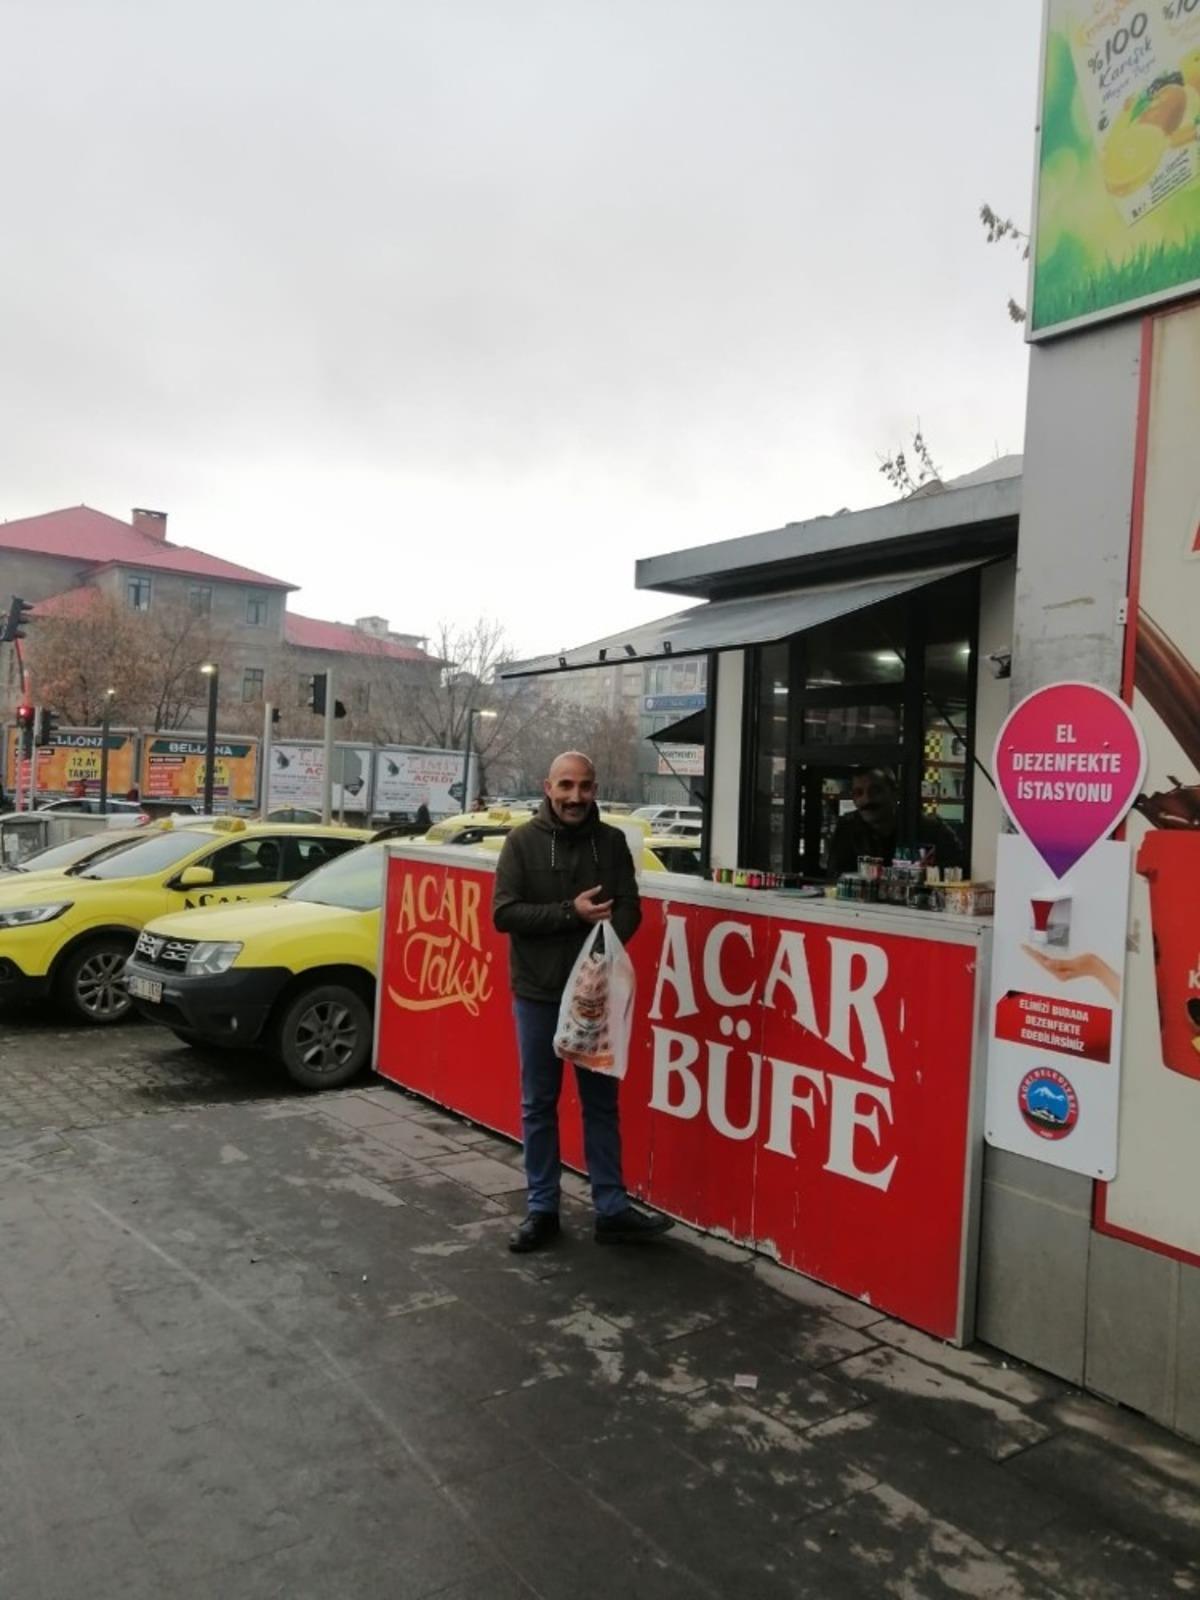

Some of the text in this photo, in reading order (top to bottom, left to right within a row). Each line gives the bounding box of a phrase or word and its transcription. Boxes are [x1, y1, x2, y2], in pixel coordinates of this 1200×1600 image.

[1088, 12, 1149, 75] %100
[1056, 724, 1077, 744] EL
[169, 742, 233, 756] BELLNA
[1012, 753, 1121, 773] DEZENFEKTE
[1017, 776, 1113, 803] İSTASYONU
[396, 873, 483, 952] ACAR
[388, 932, 494, 1017] Taksi
[648, 914, 895, 1083] ACAR
[1025, 1014, 1081, 1036] DEZENFEKTE
[1051, 1004, 1089, 1023] BURADA
[648, 1015, 898, 1192] BÜFE
